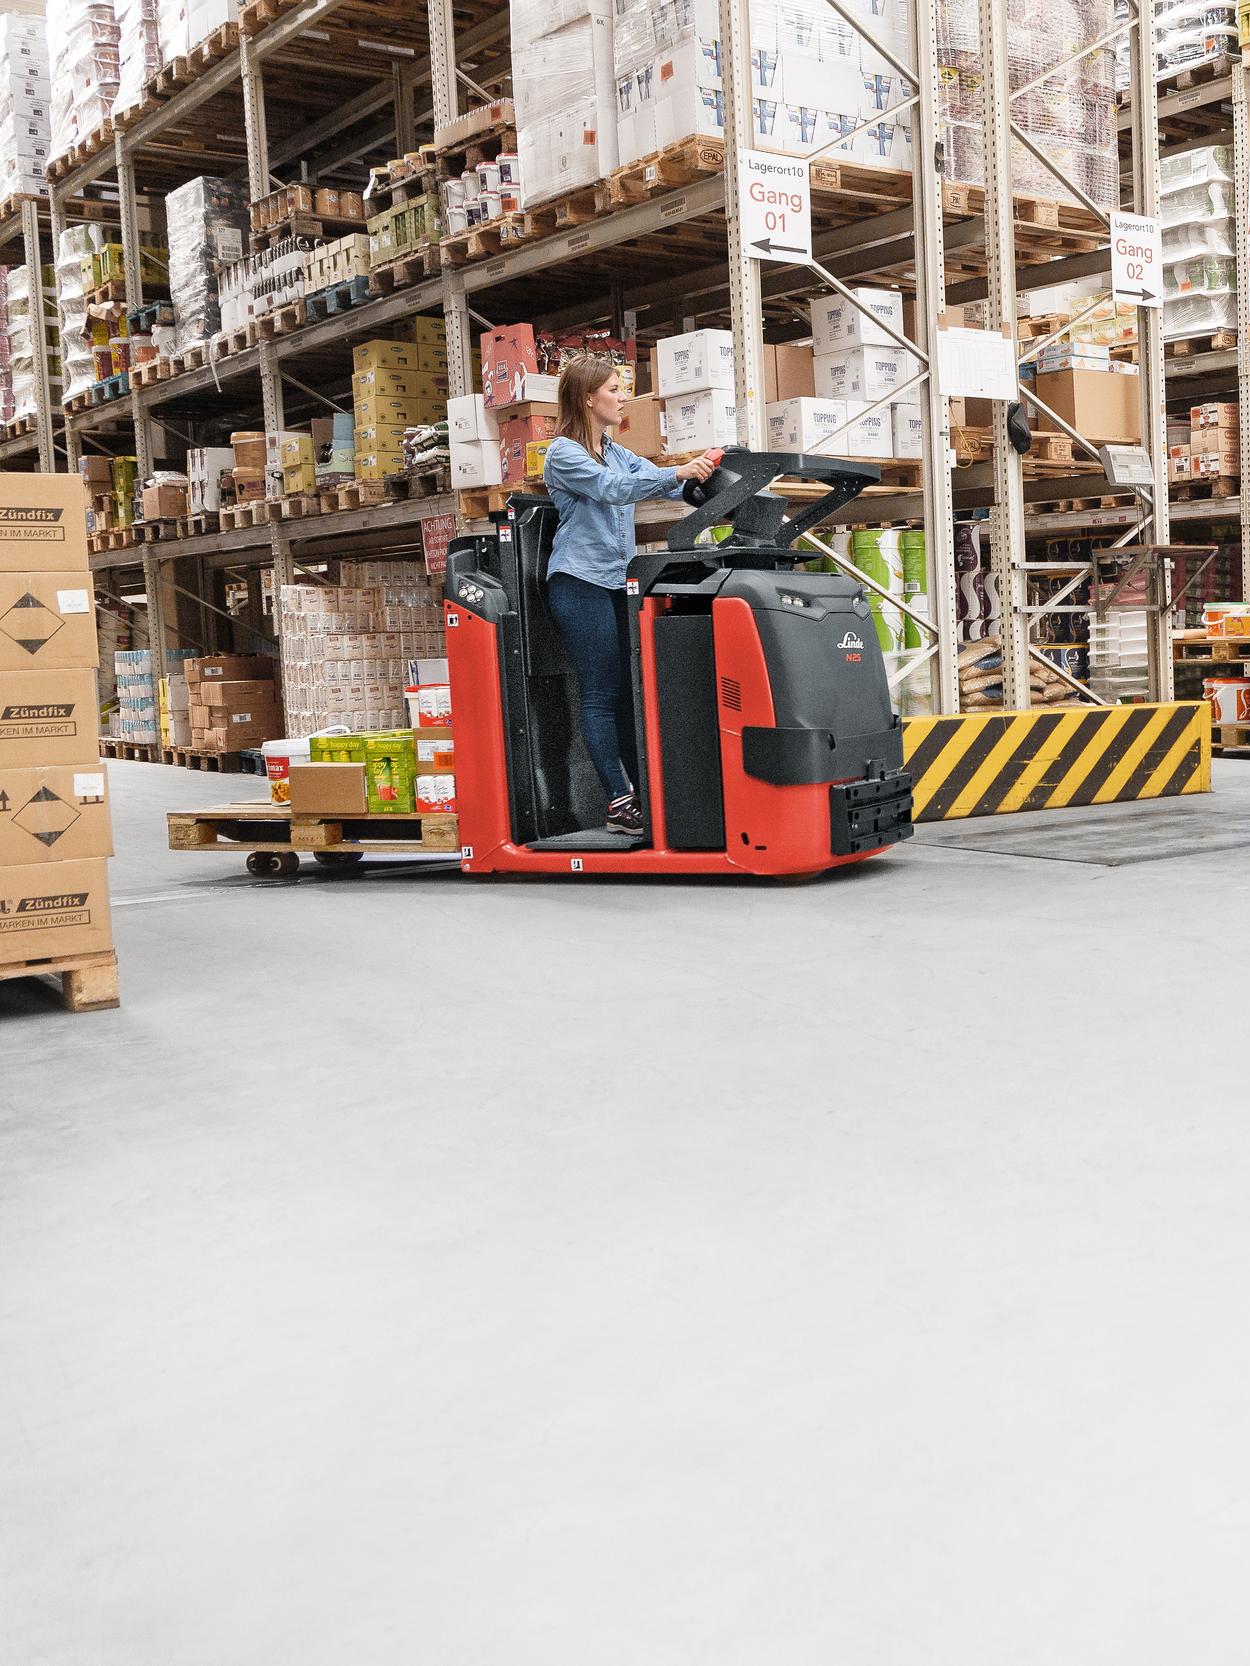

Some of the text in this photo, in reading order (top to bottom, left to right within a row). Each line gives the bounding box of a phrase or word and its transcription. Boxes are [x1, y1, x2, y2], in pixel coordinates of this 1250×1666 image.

[703, 151, 720, 161] EPAL
[748, 158, 804, 178] Lagerort10
[749, 182, 802, 213] Gang
[765, 211, 786, 233] 01
[1114, 218, 1154, 234] Lagerort10
[1116, 238, 1153, 264] Gang
[1126, 262, 1144, 281] 02
[827, 308, 842, 321] TOPPING
[870, 303, 893, 316] TOPPING
[674, 348, 689, 362] TOPPING
[830, 364, 846, 377] TOPPING
[875, 361, 897, 373] TOPPING
[681, 404, 696, 417] TOPPING
[769, 415, 785, 427] TOPPING
[813, 412, 837, 424] TOPPING
[859, 416, 881, 428] OPPING
[0, 509, 55, 521] Zündfix
[424, 517, 453, 533] ACHTUNG
[10, 529, 22, 538] IM
[23, 529, 58, 538] MARKT
[837, 631, 864, 649] Linde
[9, 706, 67, 719] Zündfix
[22, 727, 33, 735] IM
[35, 725, 69, 734] MARKT
[330, 741, 348, 750] happy
[25, 896, 80, 909] Zündfix
[37, 917, 48, 926] IM
[51, 914, 82, 925] MARKT
